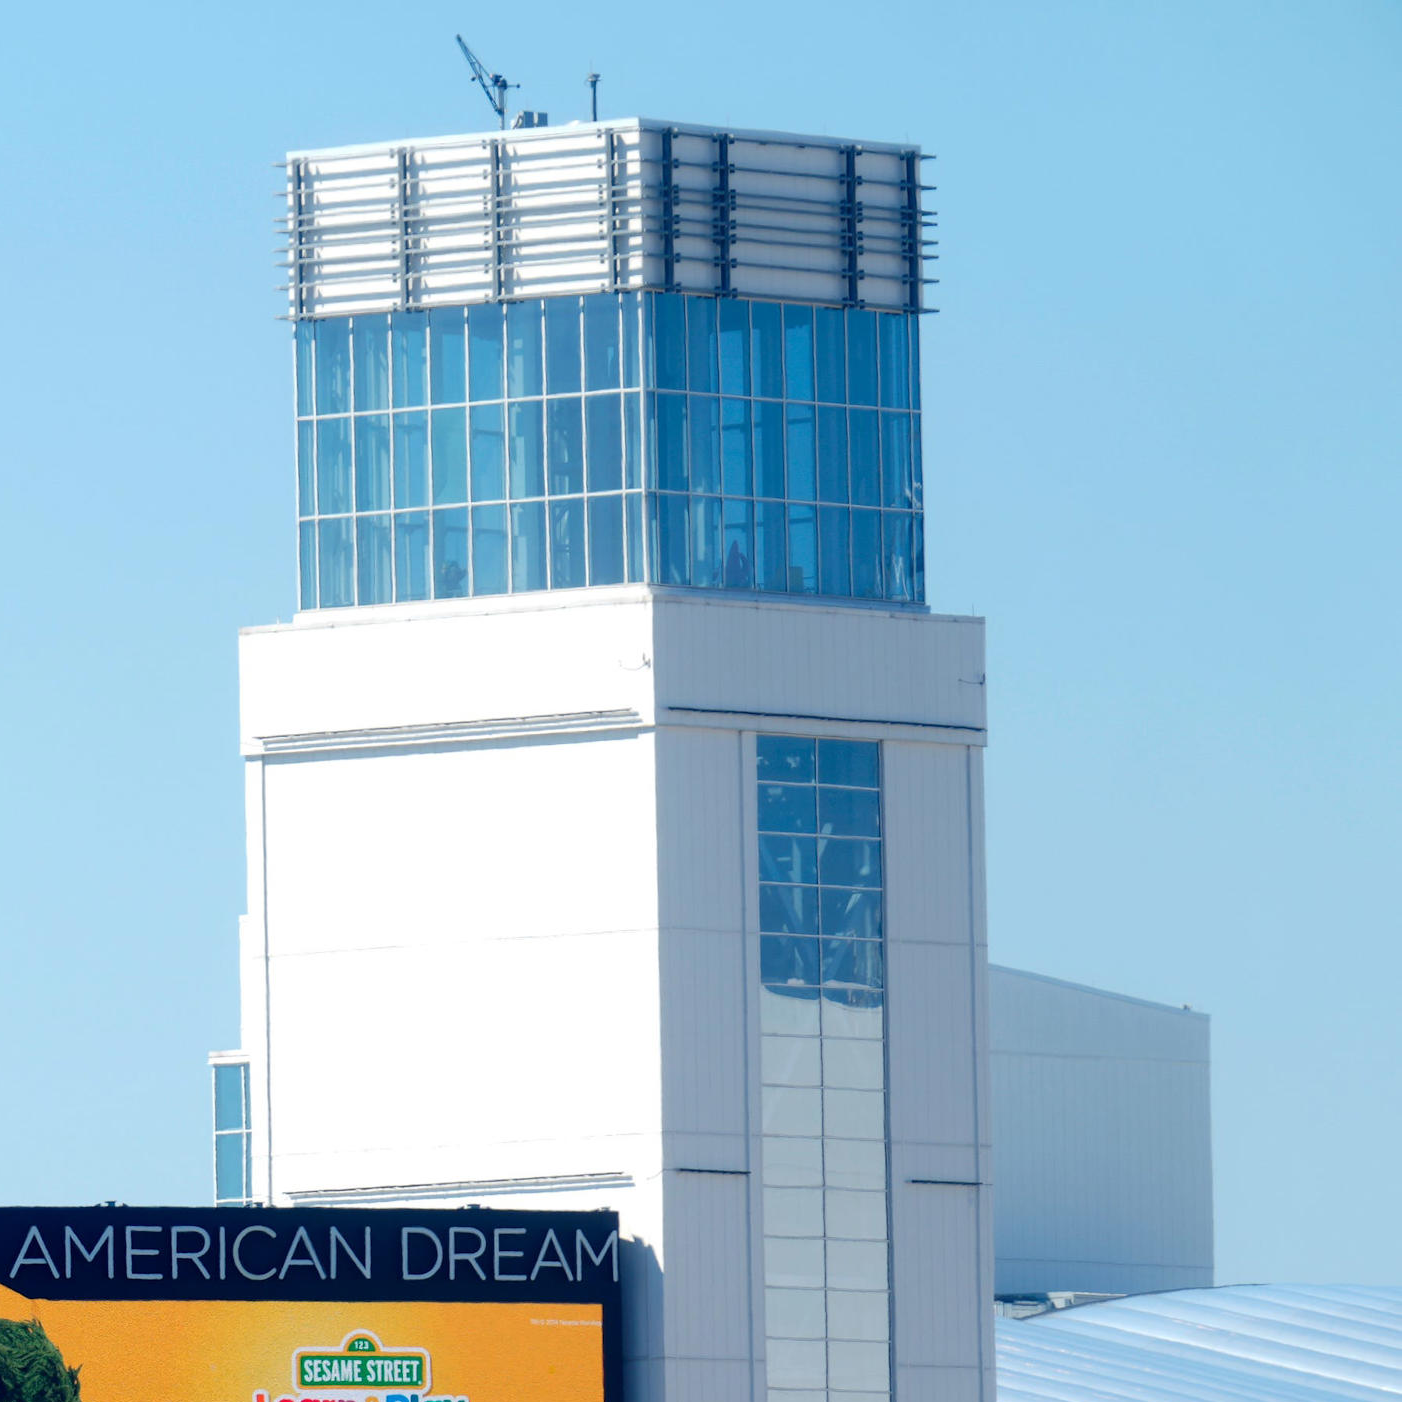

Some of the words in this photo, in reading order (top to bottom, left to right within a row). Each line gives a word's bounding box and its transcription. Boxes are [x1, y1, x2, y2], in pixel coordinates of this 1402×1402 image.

[8, 1224, 372, 1281] AMERICAN
[400, 1225, 620, 1283] DREAM
[353, 1340, 370, 1350] 123
[303, 1359, 362, 1383] SESAME
[365, 1359, 420, 1383] STREET
